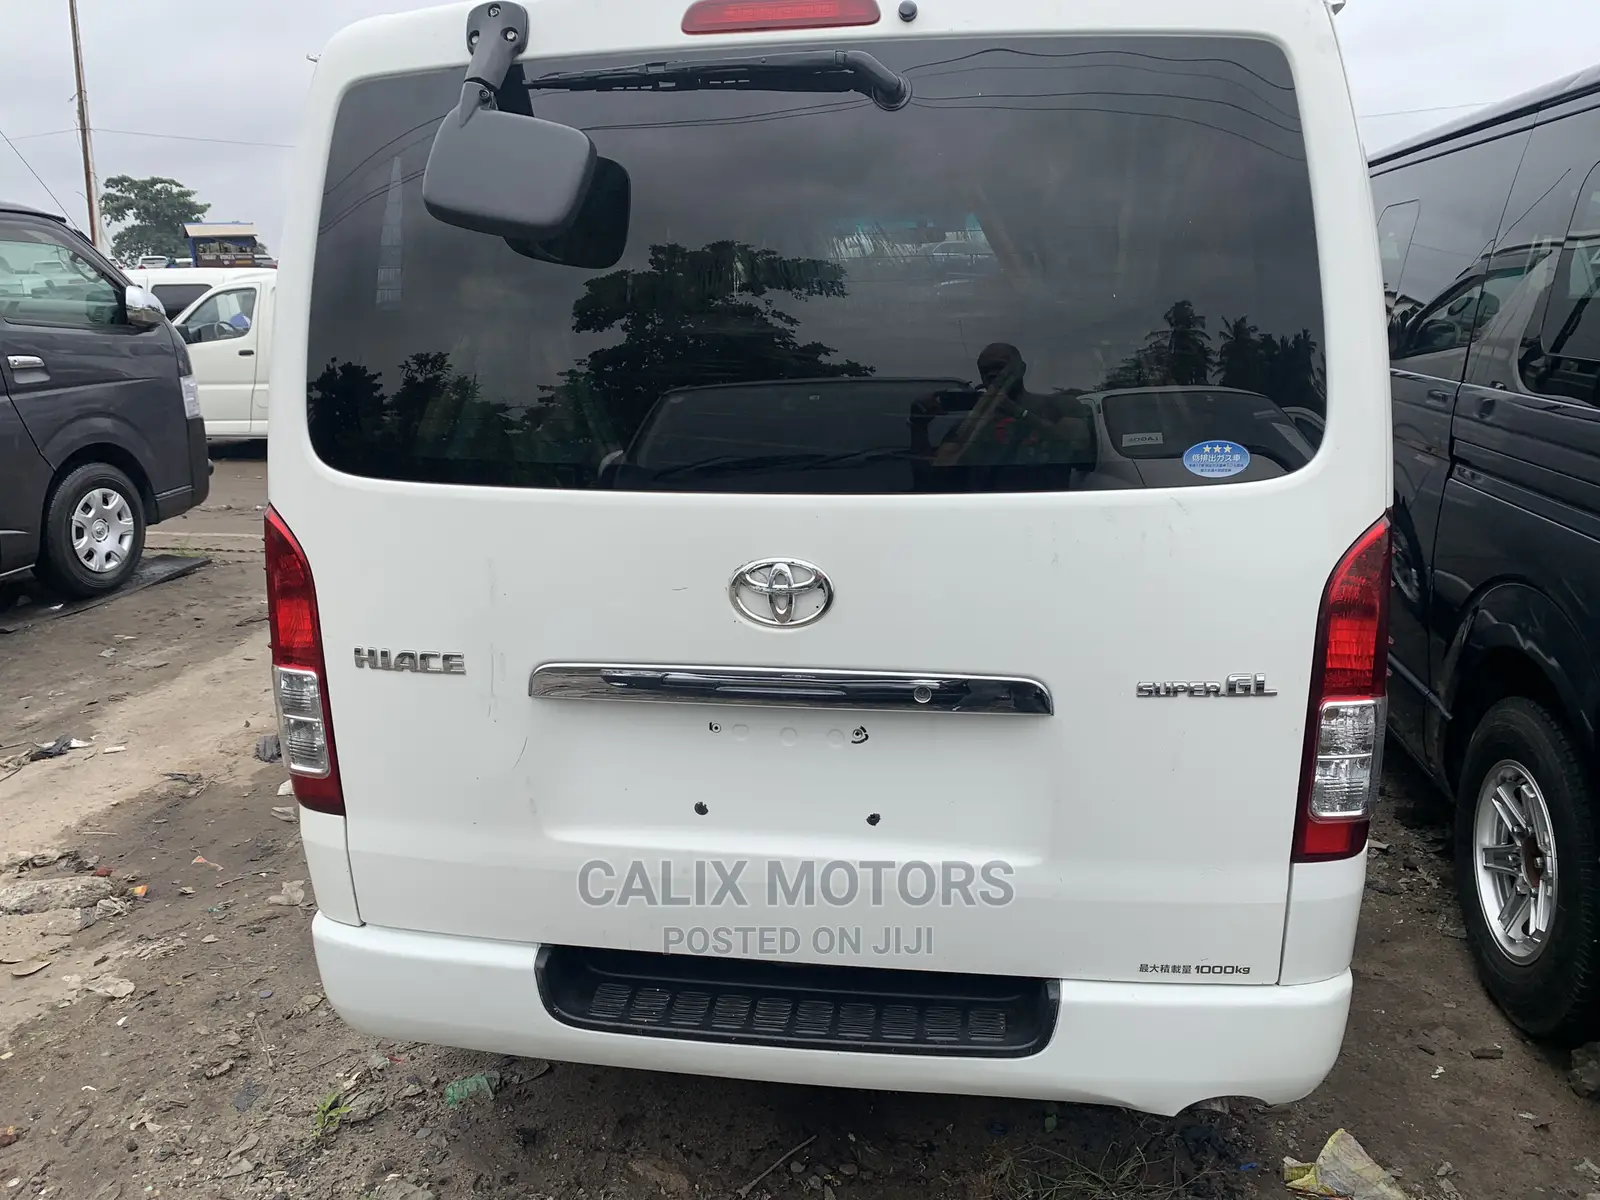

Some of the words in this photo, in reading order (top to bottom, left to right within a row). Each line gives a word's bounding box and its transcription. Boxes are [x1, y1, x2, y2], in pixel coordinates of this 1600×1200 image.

[354, 646, 466, 675] HIACE
[1136, 681, 1220, 697] SUPER
[1226, 672, 1278, 697] GL
[1139, 963, 1192, 974] 最大積載量
[1194, 965, 1251, 975] 1000kg
